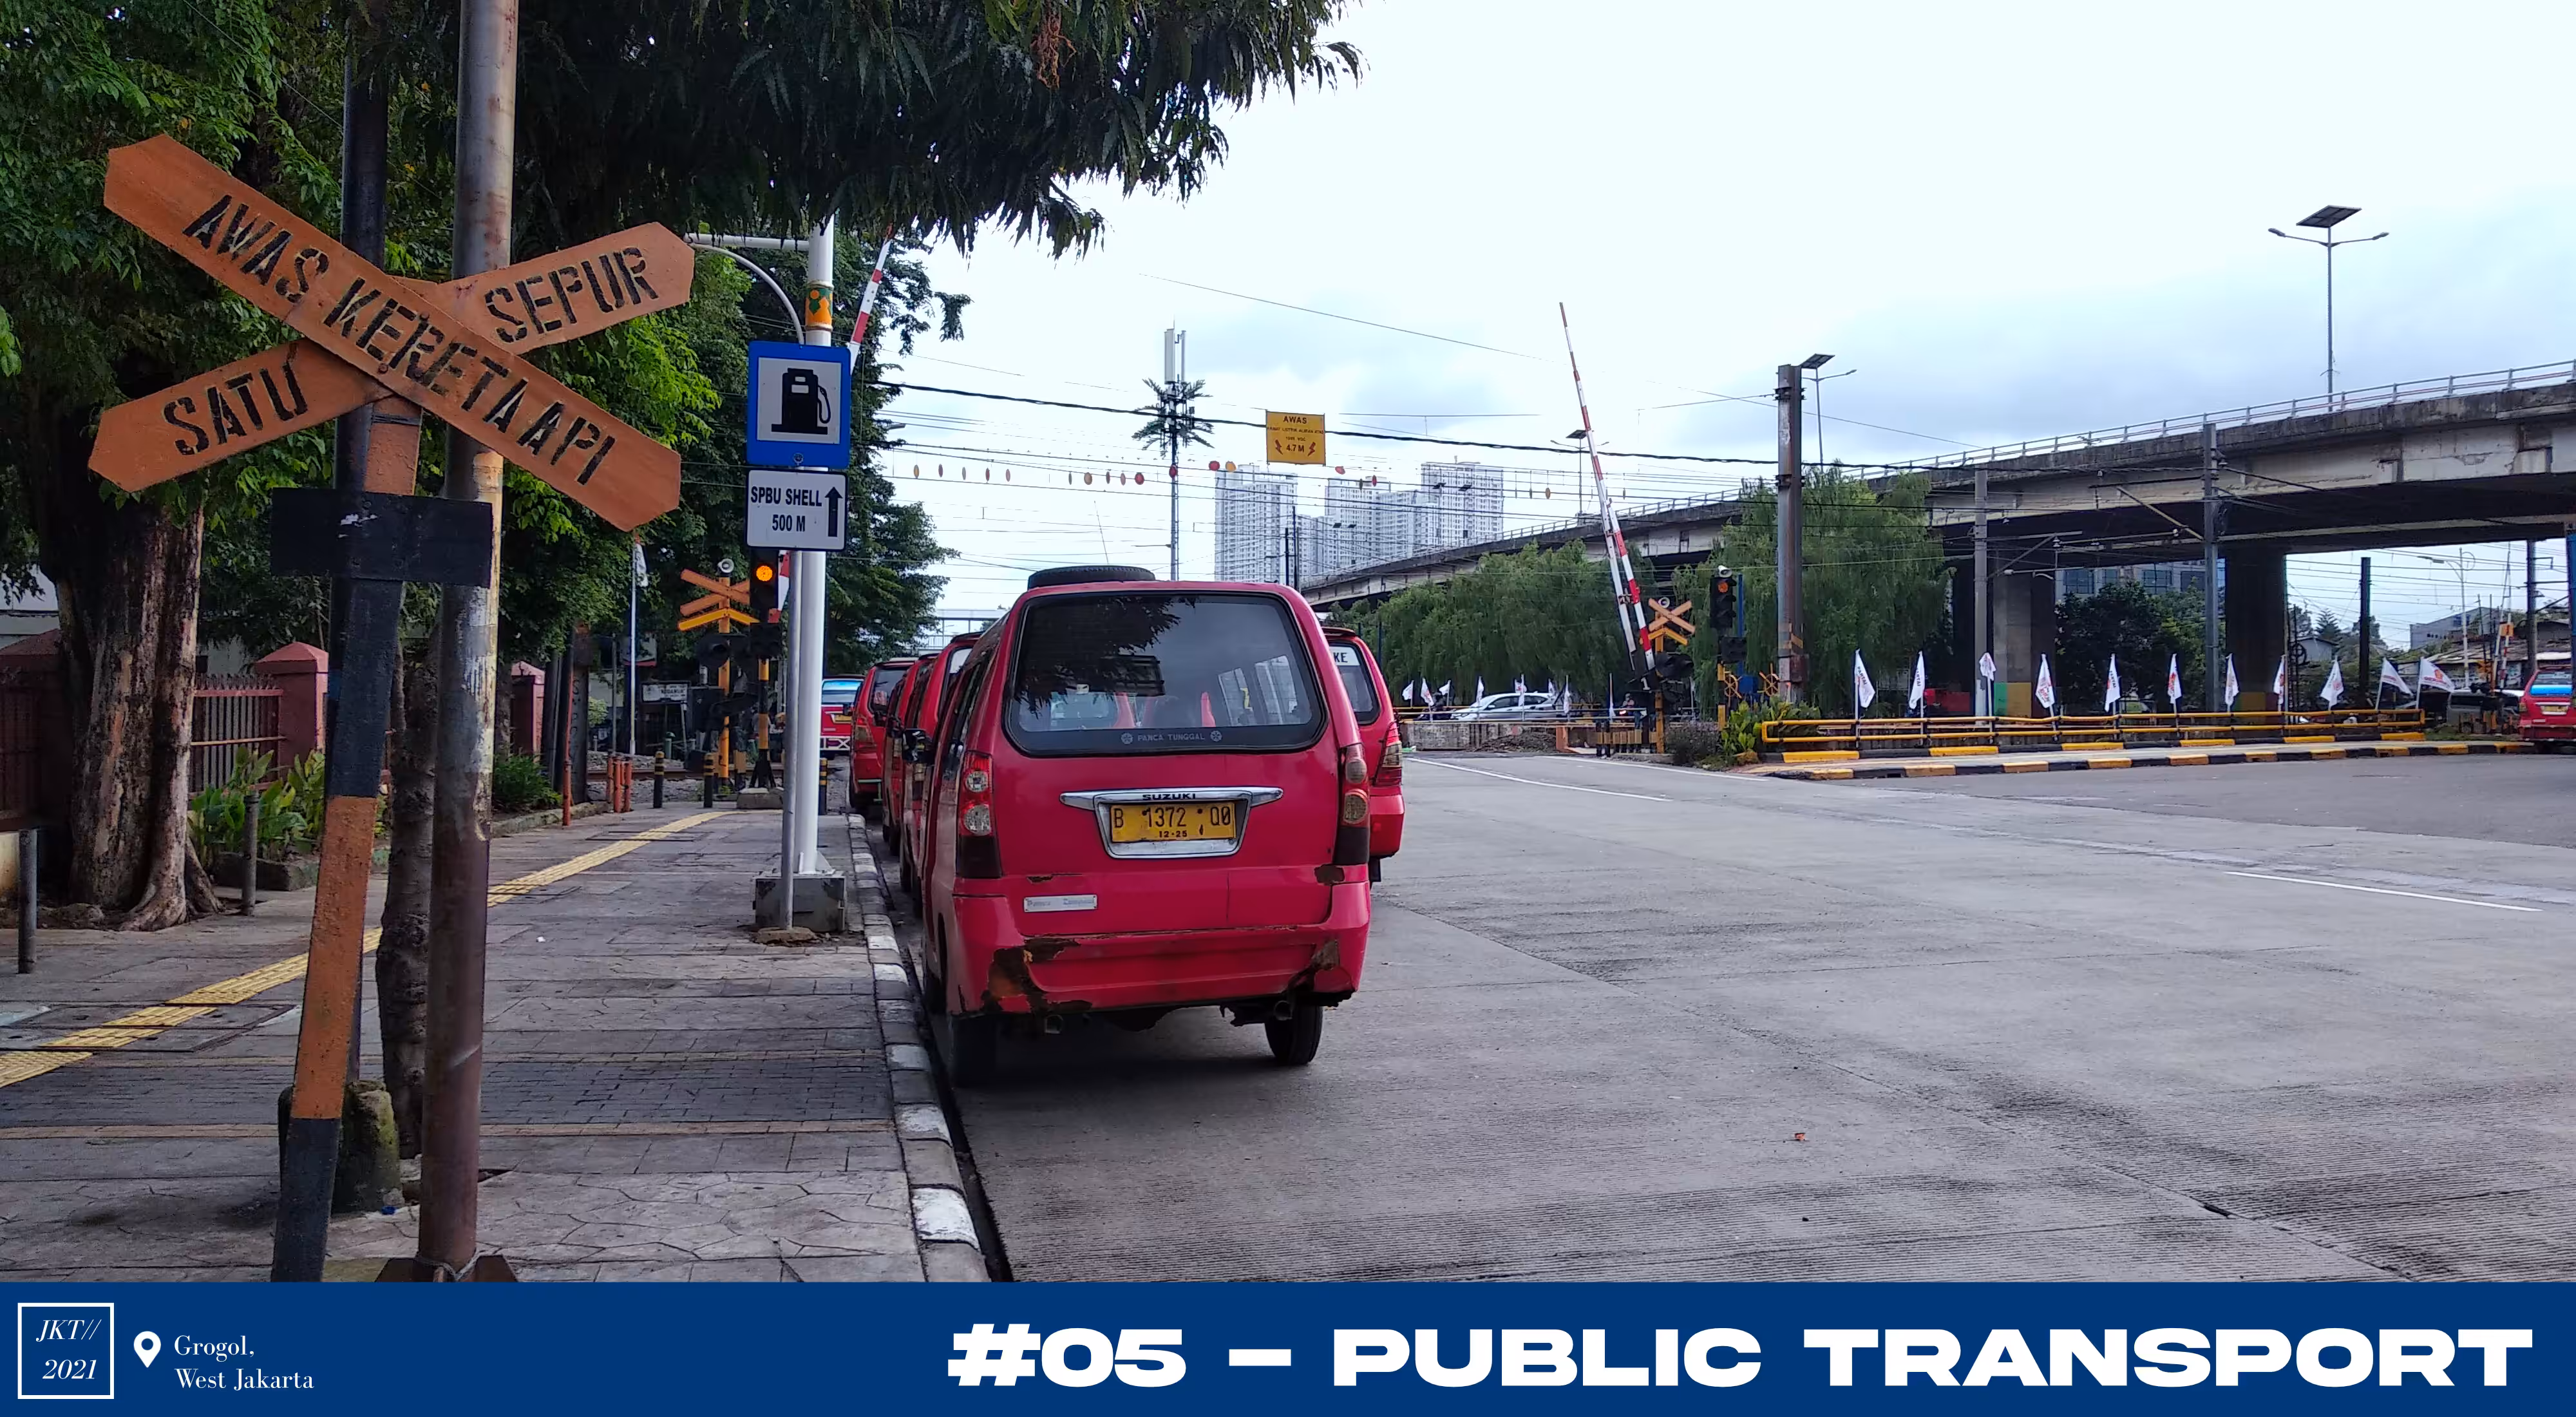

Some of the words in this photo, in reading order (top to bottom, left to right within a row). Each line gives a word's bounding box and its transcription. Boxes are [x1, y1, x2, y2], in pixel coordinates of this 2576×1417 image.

[182, 195, 330, 304] AWAS
[162, 344, 308, 456] SATU
[484, 247, 659, 343] SEPUR
[1283, 415, 1307, 424] AWAS
[750, 486, 782, 504] SPBU
[785, 488, 822, 507] SHELL
[772, 514, 793, 531] 500
[796, 515, 806, 532] M
[1640, 677, 1651, 690] 1
[1142, 793, 1197, 801] SUZUKI
[1113, 808, 1124, 828] B
[1146, 806, 1187, 828] 1372
